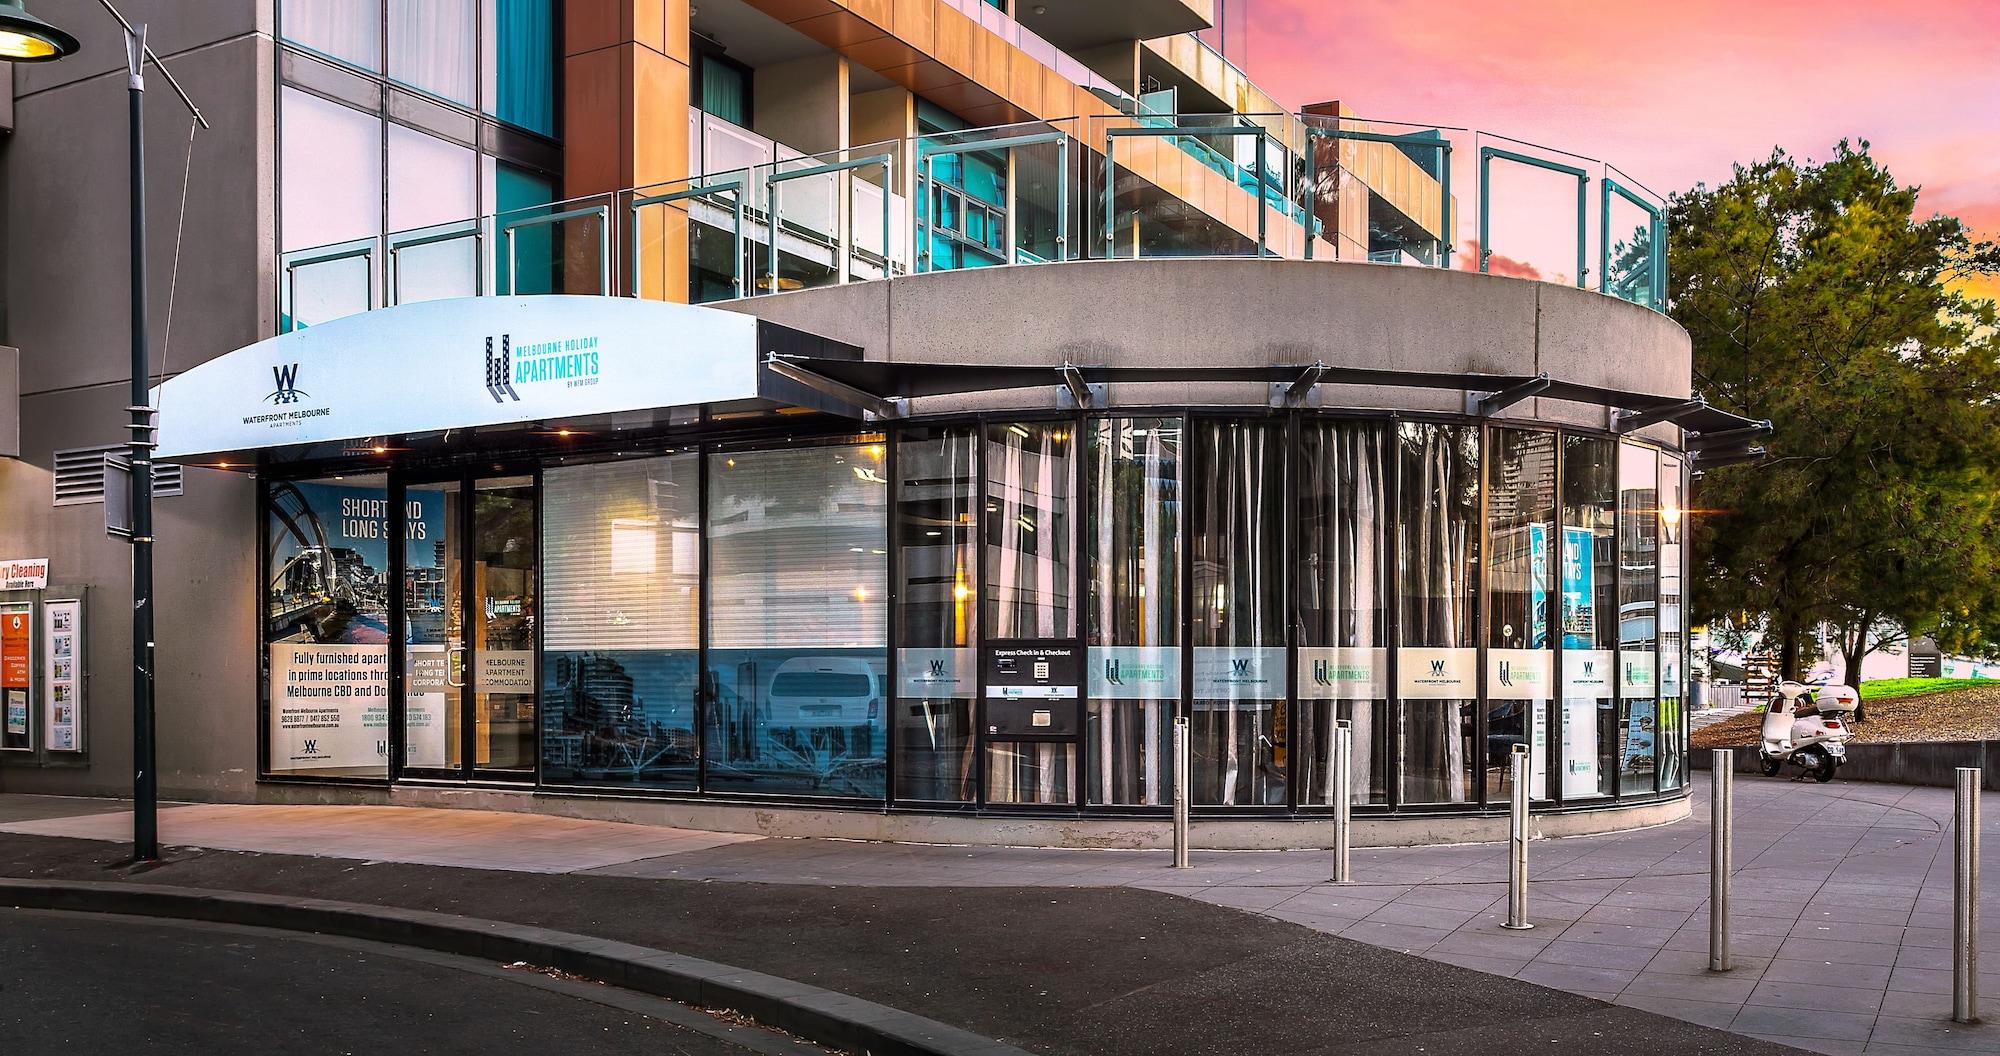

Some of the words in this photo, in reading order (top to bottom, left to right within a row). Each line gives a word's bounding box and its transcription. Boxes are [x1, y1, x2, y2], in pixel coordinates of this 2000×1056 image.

[516, 341, 561, 357] MELBOURNE
[565, 336, 599, 351] HOLIDAY
[515, 352, 599, 384] APARTMENTS
[242, 412, 287, 425] WATERFRONT
[288, 407, 330, 420] MELBOURNE
[269, 419, 302, 428] APARTMENTS
[342, 498, 388, 518] SHORT
[342, 519, 378, 539] LONG
[0, 567, 9, 579] ry
[11, 563, 45, 578] Cleaning
[294, 652, 314, 665] Fully
[317, 651, 359, 664] furnished
[288, 669, 297, 681] in
[298, 669, 323, 682] prime
[325, 669, 368, 681] locations
[1121, 670, 1165, 679] APARTMENTS
[1328, 670, 1370, 680] APARTMENTS
[287, 685, 332, 697] Melbourne
[334, 685, 352, 697] CBD
[354, 685, 372, 697] and
